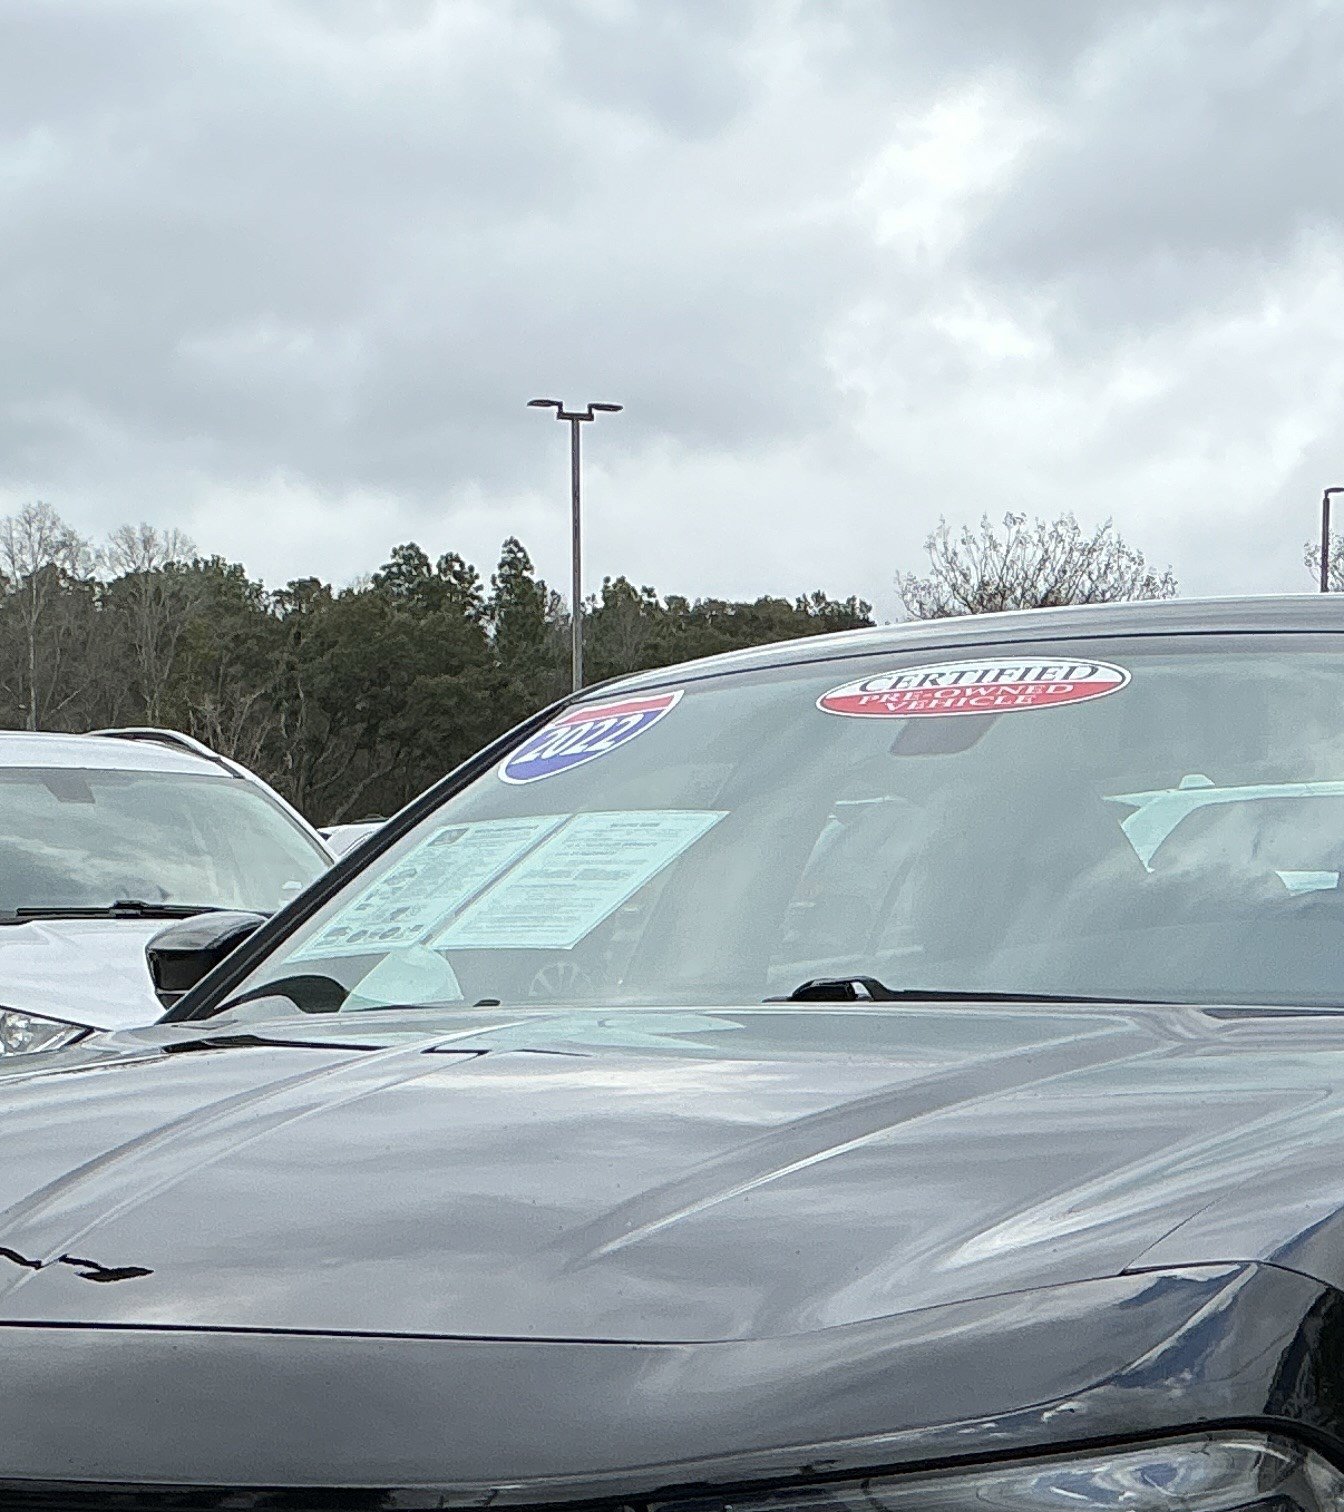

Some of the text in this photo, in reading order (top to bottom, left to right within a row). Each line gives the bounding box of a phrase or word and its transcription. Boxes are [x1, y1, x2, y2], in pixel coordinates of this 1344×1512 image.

[859, 665, 1100, 693] CERTIFIED
[859, 684, 1074, 706] PRE-OWNED
[885, 694, 1035, 712] VEHICLE
[510, 713, 645, 765] 2022
